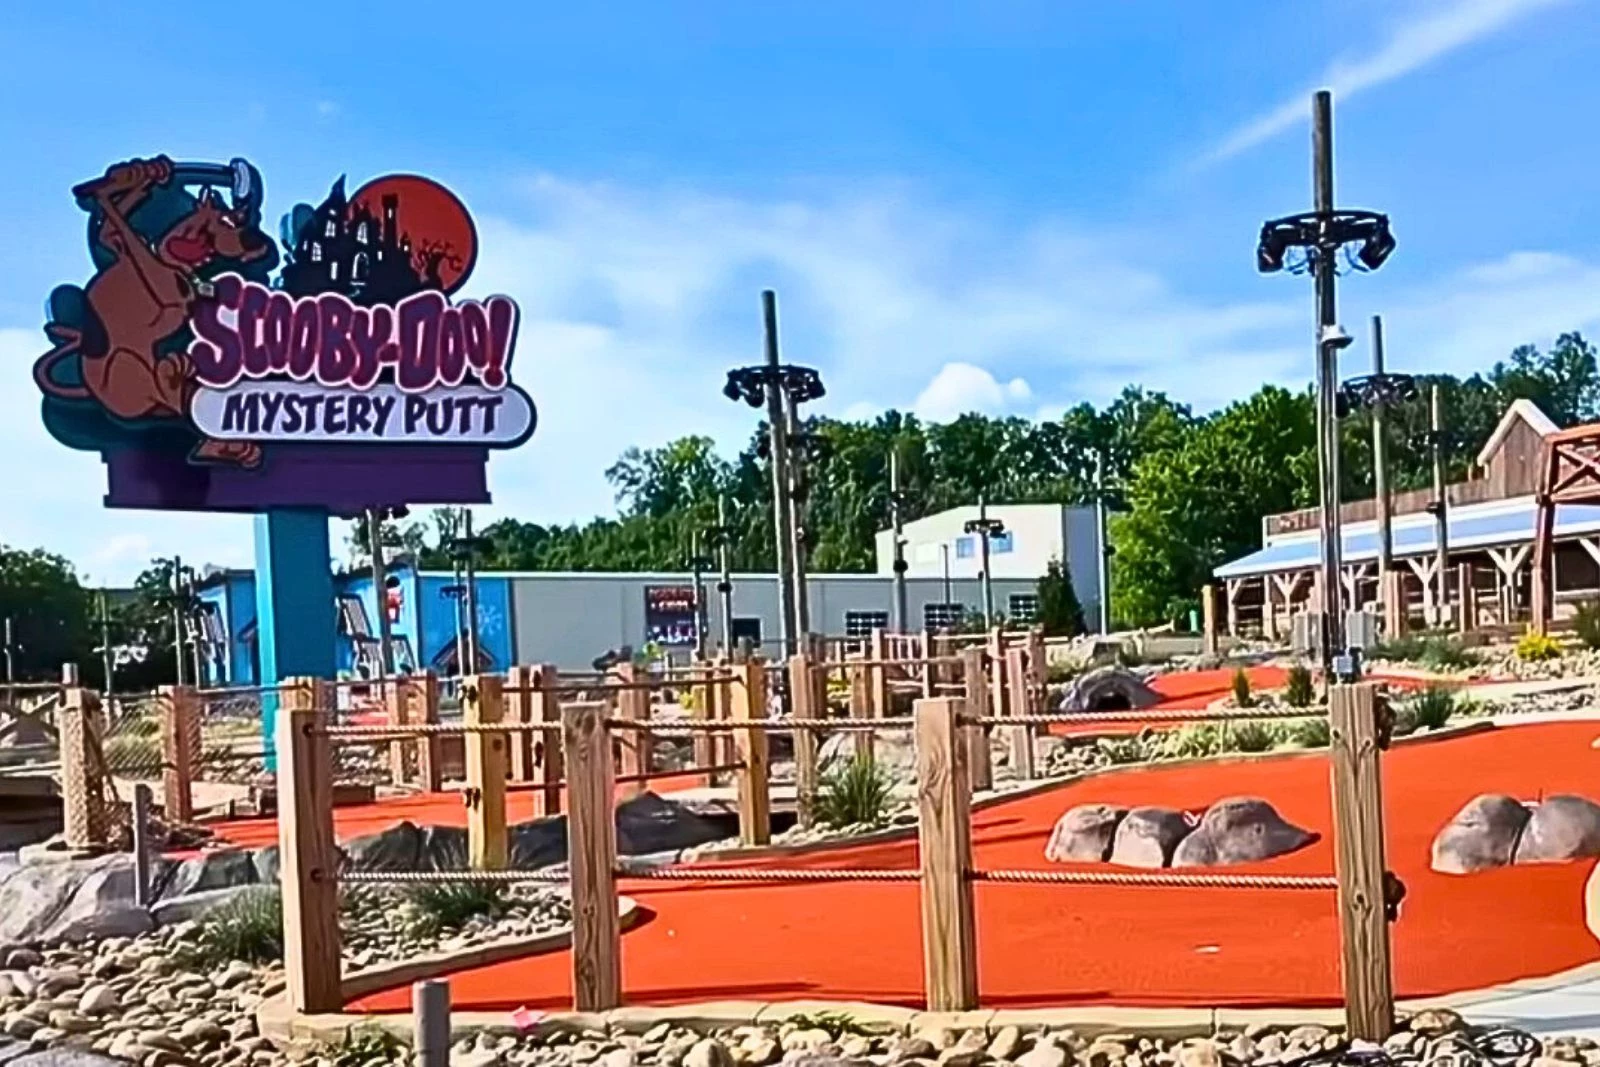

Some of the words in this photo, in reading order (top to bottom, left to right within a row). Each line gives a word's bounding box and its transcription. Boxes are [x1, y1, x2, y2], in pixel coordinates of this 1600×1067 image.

[189, 272, 514, 391] SCOOBY-DOO!
[221, 392, 396, 436] MYSTERY
[404, 394, 503, 435] PUTT
